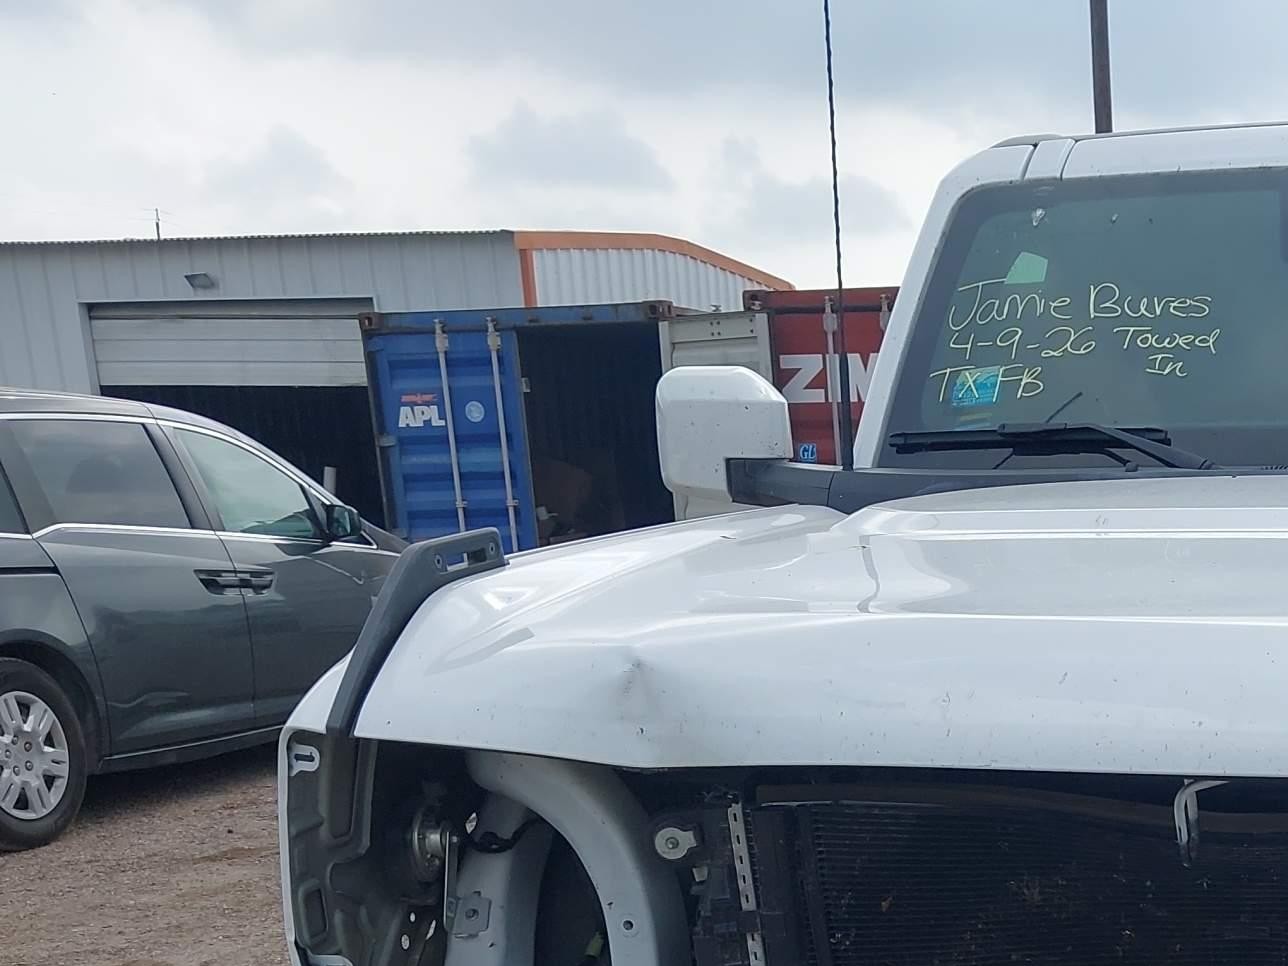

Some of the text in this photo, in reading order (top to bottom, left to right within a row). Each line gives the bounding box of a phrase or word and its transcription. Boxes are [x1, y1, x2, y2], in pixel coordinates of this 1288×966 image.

[949, 278, 1072, 330] Jamie
[949, 326, 1221, 360] 4-9-26 Towed
[1145, 353, 1188, 377] In
[398, 405, 445, 428] APL
